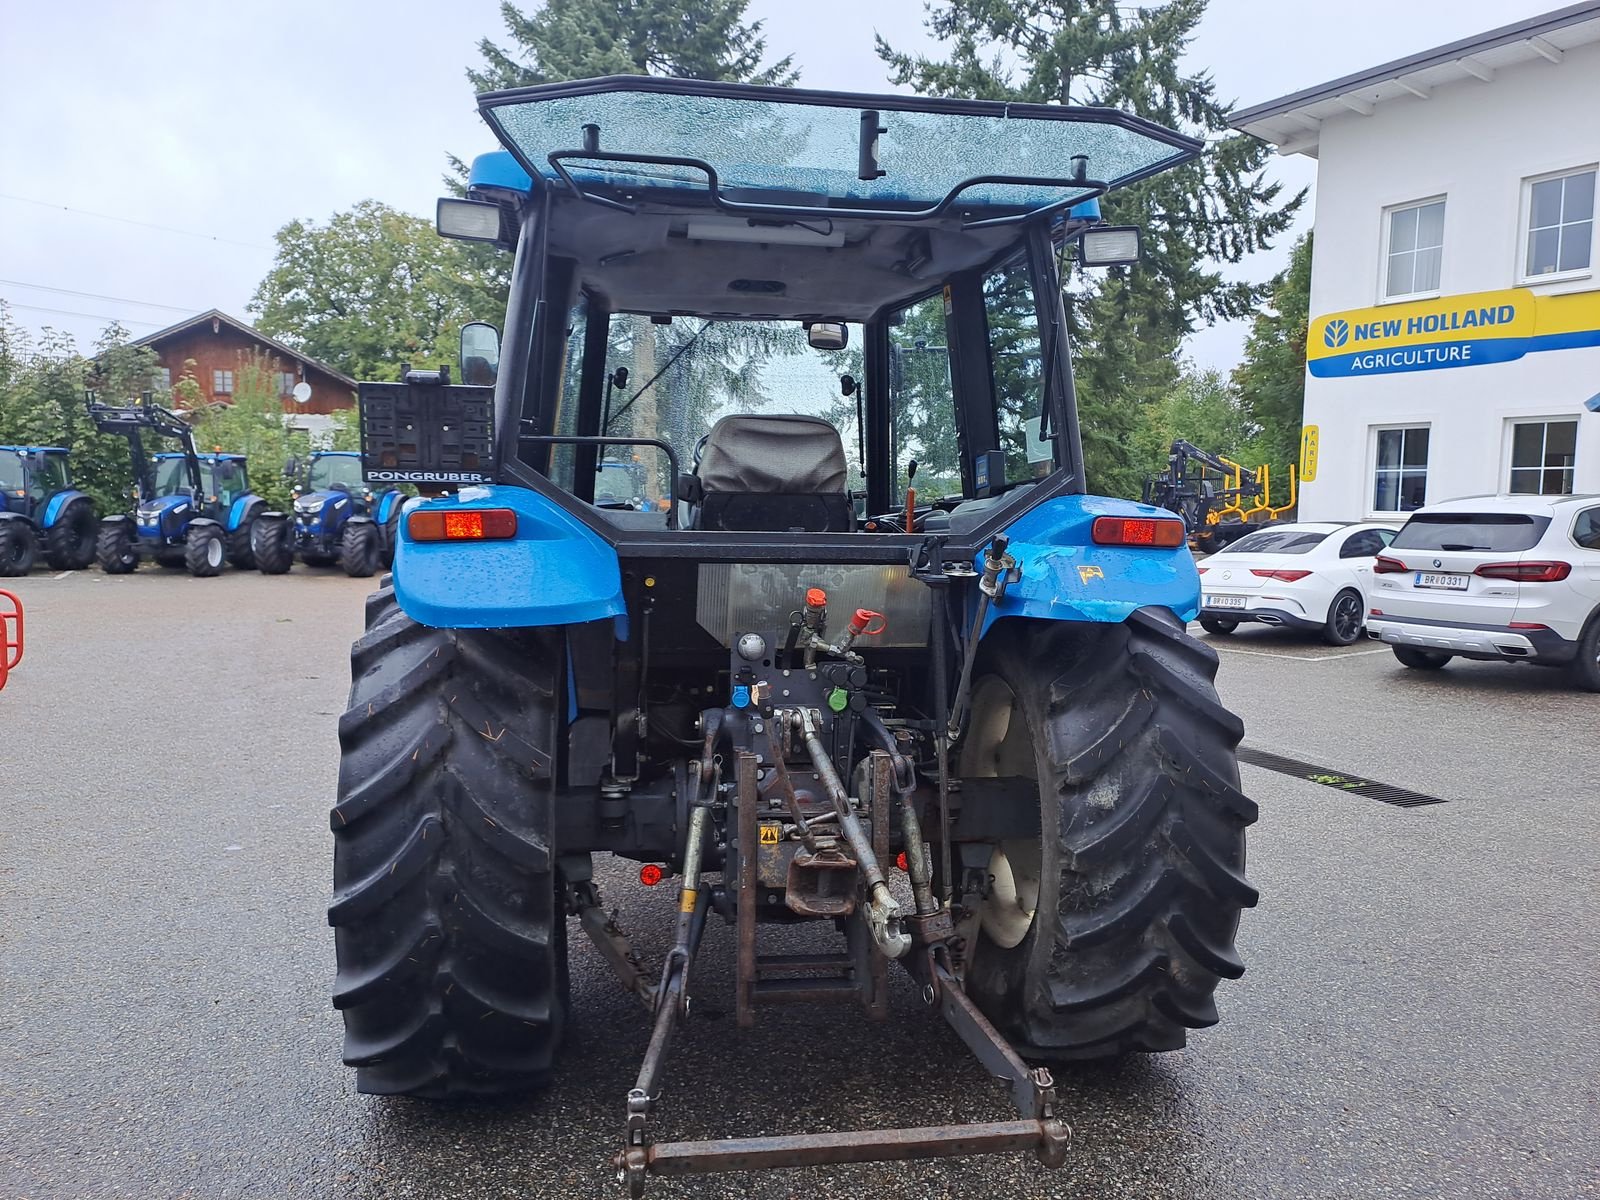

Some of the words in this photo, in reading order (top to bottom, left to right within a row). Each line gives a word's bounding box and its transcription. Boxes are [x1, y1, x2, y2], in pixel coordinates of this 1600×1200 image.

[1354, 319, 1402, 341] NEW
[1407, 305, 1515, 335] HOLLAND
[1351, 345, 1472, 370] AGRICULTURE
[1308, 430, 1316, 476] PARTS
[367, 471, 482, 482] PONGRUBER
[1424, 575, 1435, 584] BR
